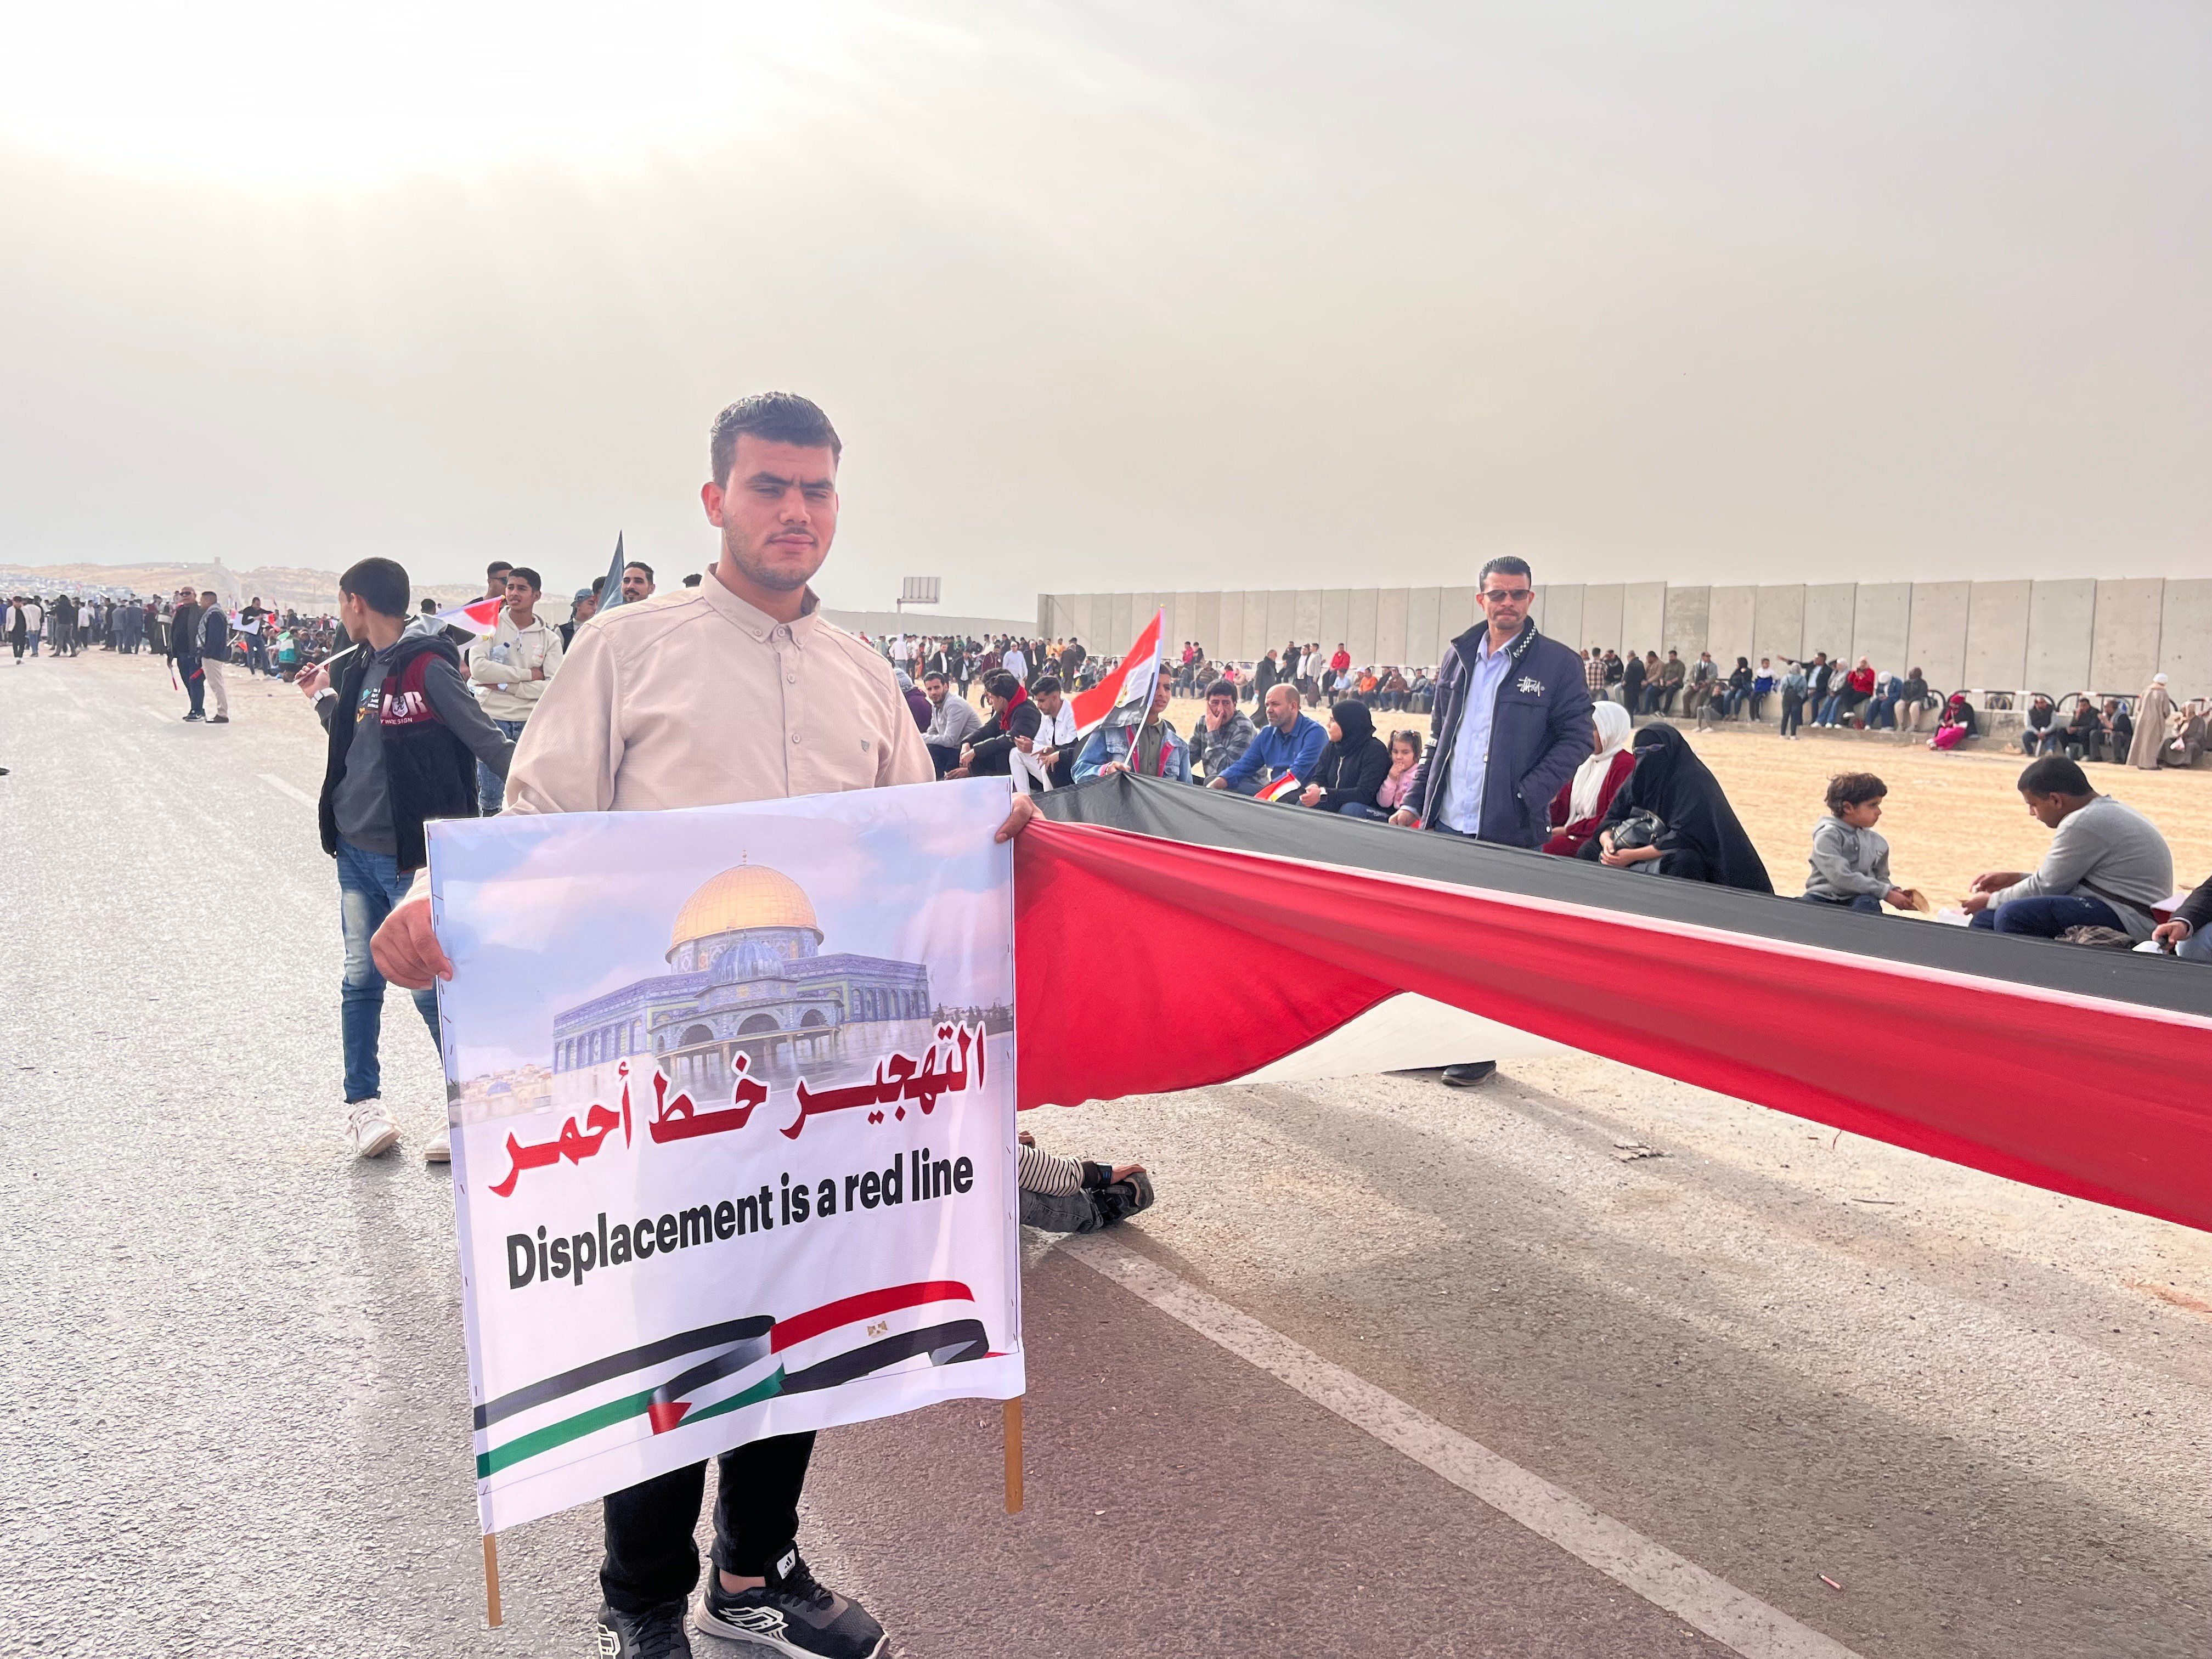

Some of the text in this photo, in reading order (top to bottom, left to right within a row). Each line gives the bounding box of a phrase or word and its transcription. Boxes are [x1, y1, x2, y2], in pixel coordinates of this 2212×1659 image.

[488, 1025, 984, 1197] التهجير خط أحمر
[506, 1147, 973, 1290] Displacement is a red line
